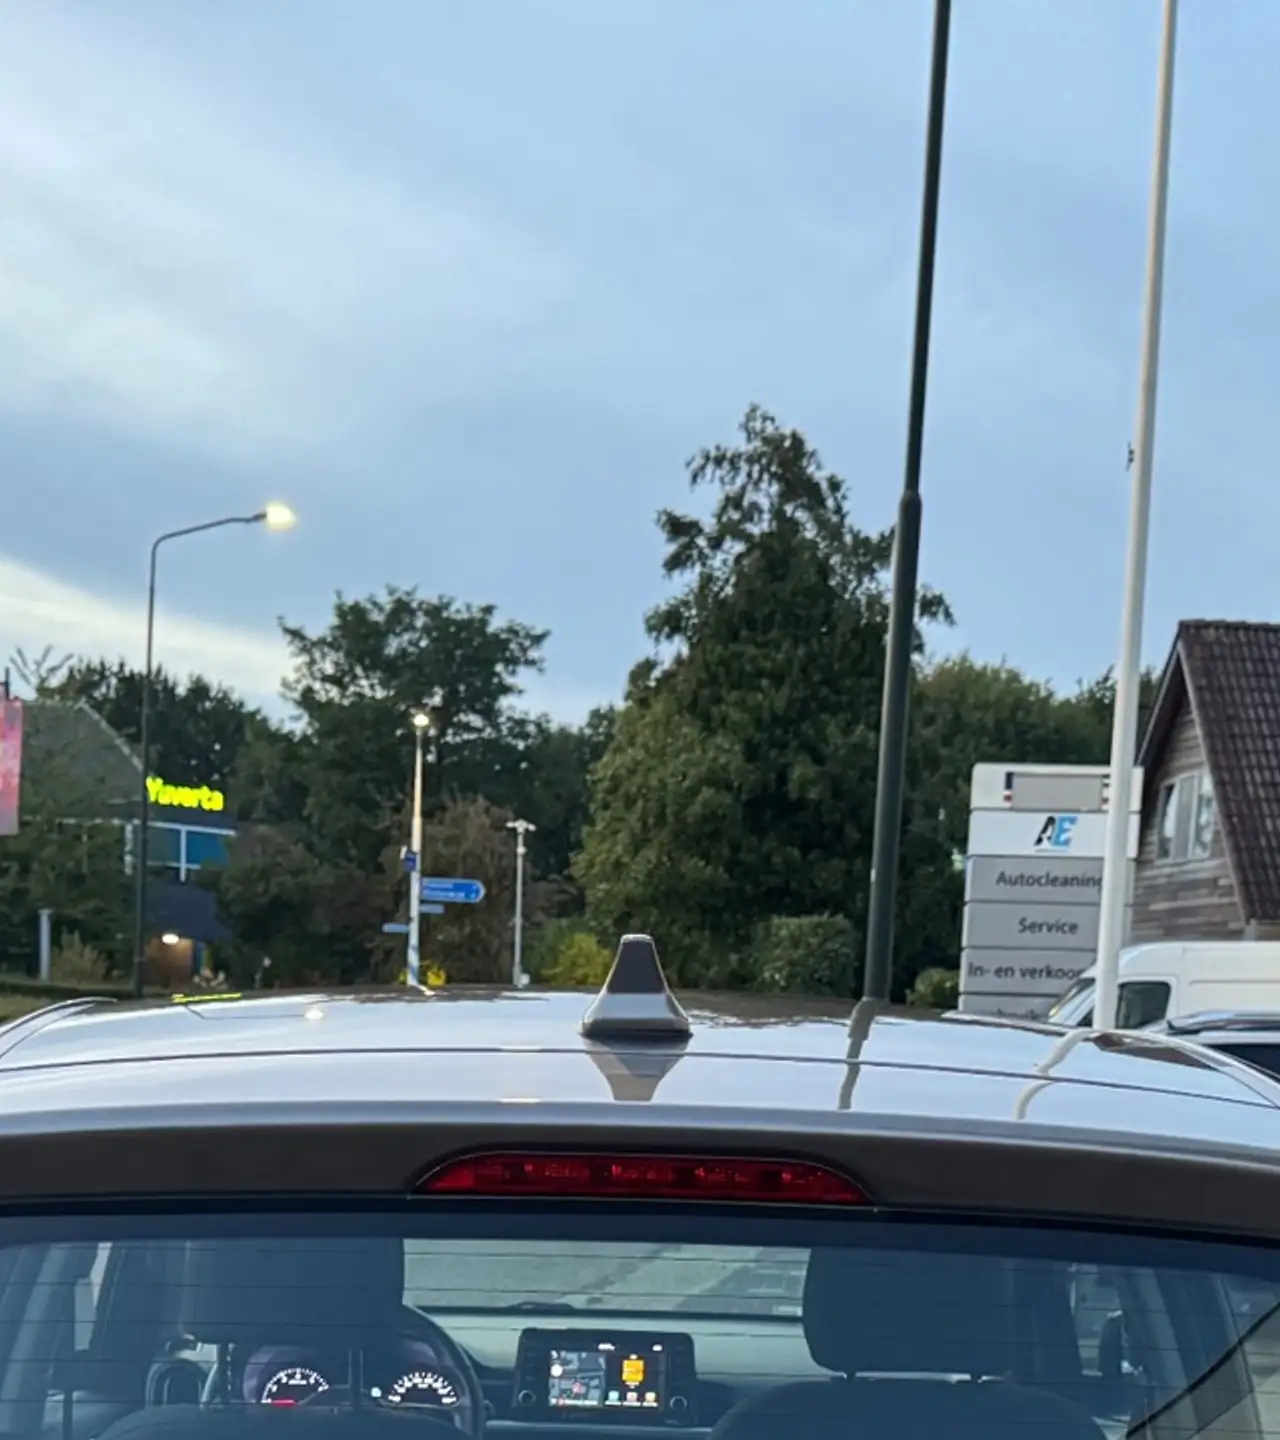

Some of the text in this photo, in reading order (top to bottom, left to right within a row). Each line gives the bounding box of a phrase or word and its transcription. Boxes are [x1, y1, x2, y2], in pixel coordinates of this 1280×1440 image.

[145, 775, 224, 811] Yuverta
[1017, 916, 1079, 935] Service
[967, 962, 991, 978] In-
[993, 965, 1015, 979] en
